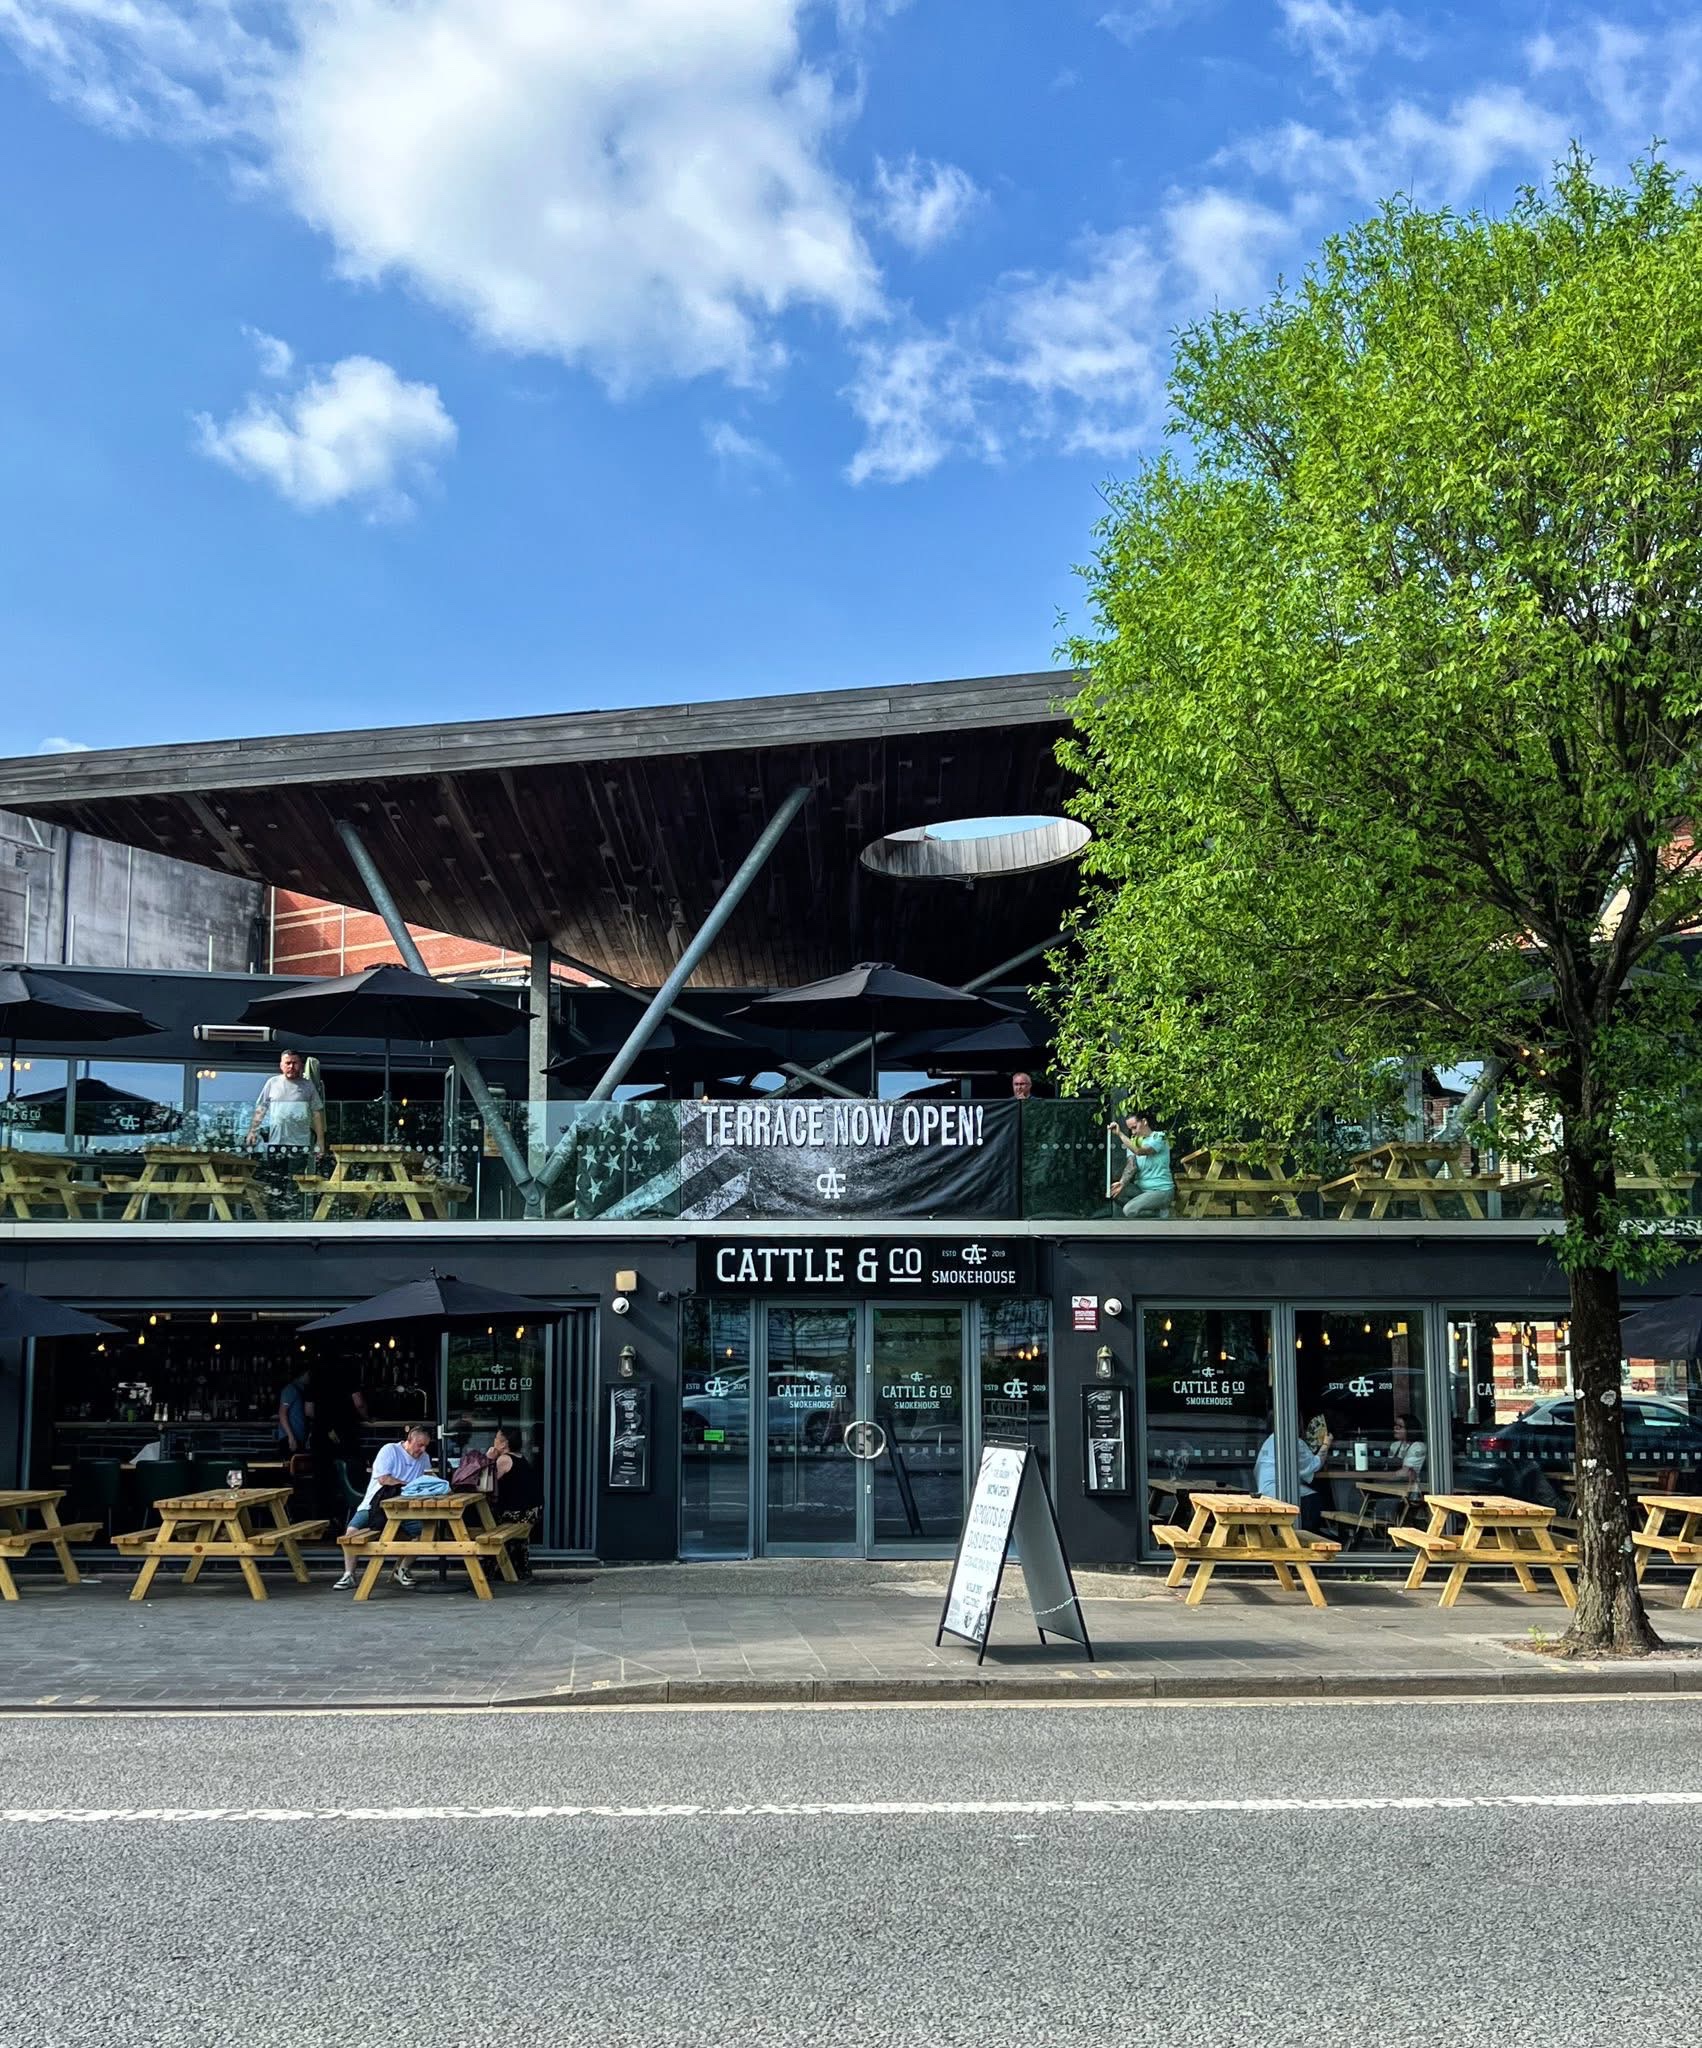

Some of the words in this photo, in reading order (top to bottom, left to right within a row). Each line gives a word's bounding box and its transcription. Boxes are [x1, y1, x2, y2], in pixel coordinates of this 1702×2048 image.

[701, 1105, 824, 1146] TERRACE
[834, 1105, 893, 1146] NOW
[902, 1105, 984, 1146] OPEN!
[992, 1250, 1006, 1258] 2019
[716, 1247, 844, 1283] CATTLE
[857, 1247, 878, 1283] &
[889, 1248, 922, 1276] CO
[932, 1269, 1016, 1284] SMOKEHOUSE
[462, 1378, 506, 1391] CATTLE
[509, 1377, 518, 1391] &
[520, 1377, 533, 1388] CO
[777, 1384, 821, 1398] CATTLE
[824, 1384, 832, 1398] &
[835, 1384, 847, 1395] CO
[1172, 1380, 1218, 1394] CATTLE
[1221, 1380, 1230, 1394] &
[1232, 1380, 1245, 1391] CO
[1378, 1382, 1393, 1390] 2019
[474, 1393, 520, 1402] SMOKEHOUSE
[882, 1385, 926, 1399] CATTLE
[929, 1385, 937, 1399] &
[940, 1385, 952, 1396] CO
[789, 1400, 835, 1409] SMOKEHOUSE
[894, 1400, 940, 1410] SMOKEHOUSE
[1185, 1397, 1233, 1406] SMOKEHOUSE
